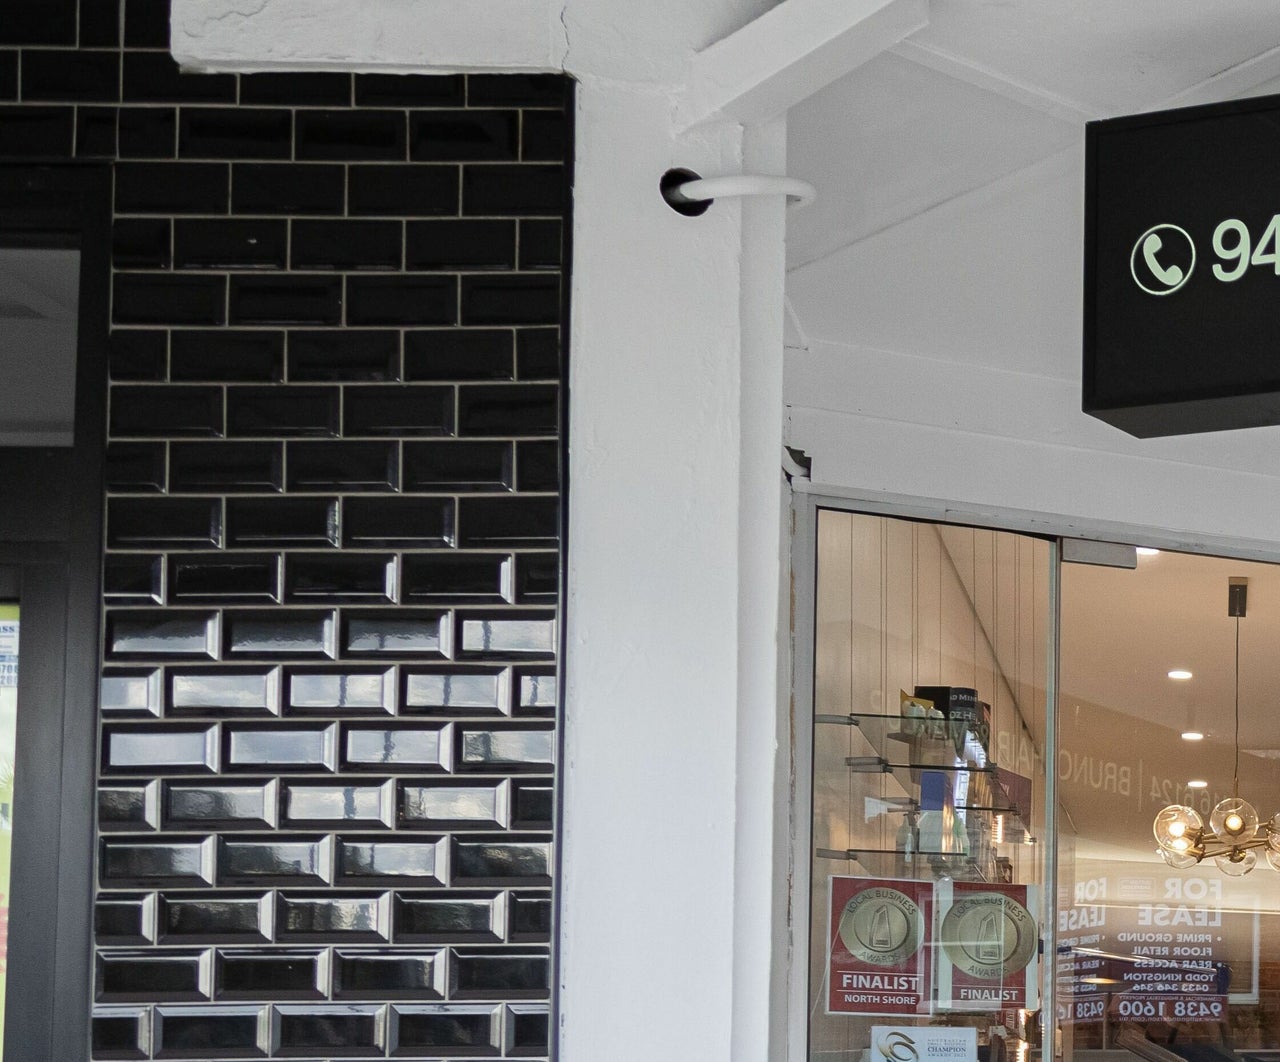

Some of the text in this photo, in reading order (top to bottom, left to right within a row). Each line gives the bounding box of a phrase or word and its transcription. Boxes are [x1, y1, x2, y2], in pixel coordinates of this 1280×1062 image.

[847, 889, 917, 915] LOCAL BUSINESS
[842, 974, 919, 990] FINALIST
[844, 994, 916, 1005] NORTH SHORE
[960, 989, 1018, 1001] FINALIST
